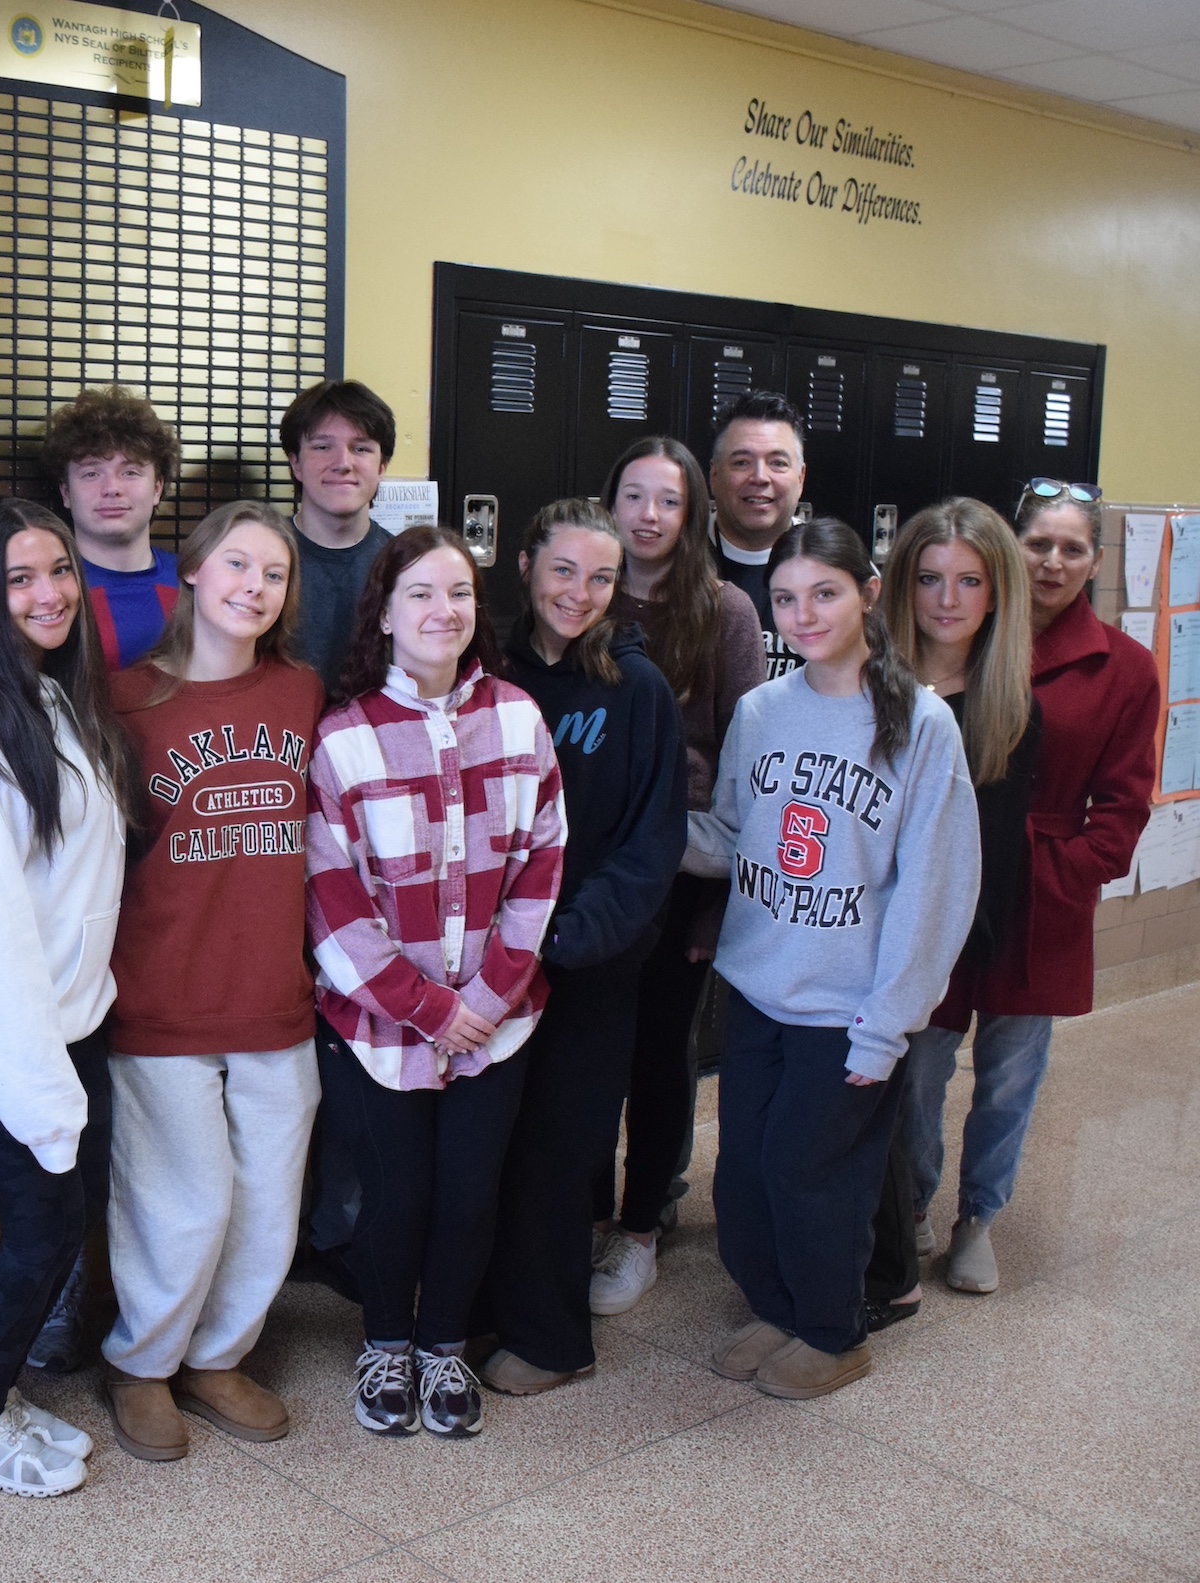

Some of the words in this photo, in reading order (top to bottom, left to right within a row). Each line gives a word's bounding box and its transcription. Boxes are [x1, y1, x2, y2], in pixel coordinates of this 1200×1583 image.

[54, 33, 79, 46] NYS
[139, 31, 189, 51] SCHOL'S
[744, 98, 791, 141] Share
[796, 110, 828, 149] Our
[832, 118, 915, 168] Similarities.
[731, 155, 801, 202] Celebrate
[807, 171, 838, 210] Our
[841, 178, 922, 225] Differences.
[149, 723, 309, 805] OAKLAN
[750, 751, 785, 800] NC
[790, 750, 895, 834] STATE
[207, 787, 283, 811] ATHLETICS
[170, 820, 306, 863] CALIFORNI
